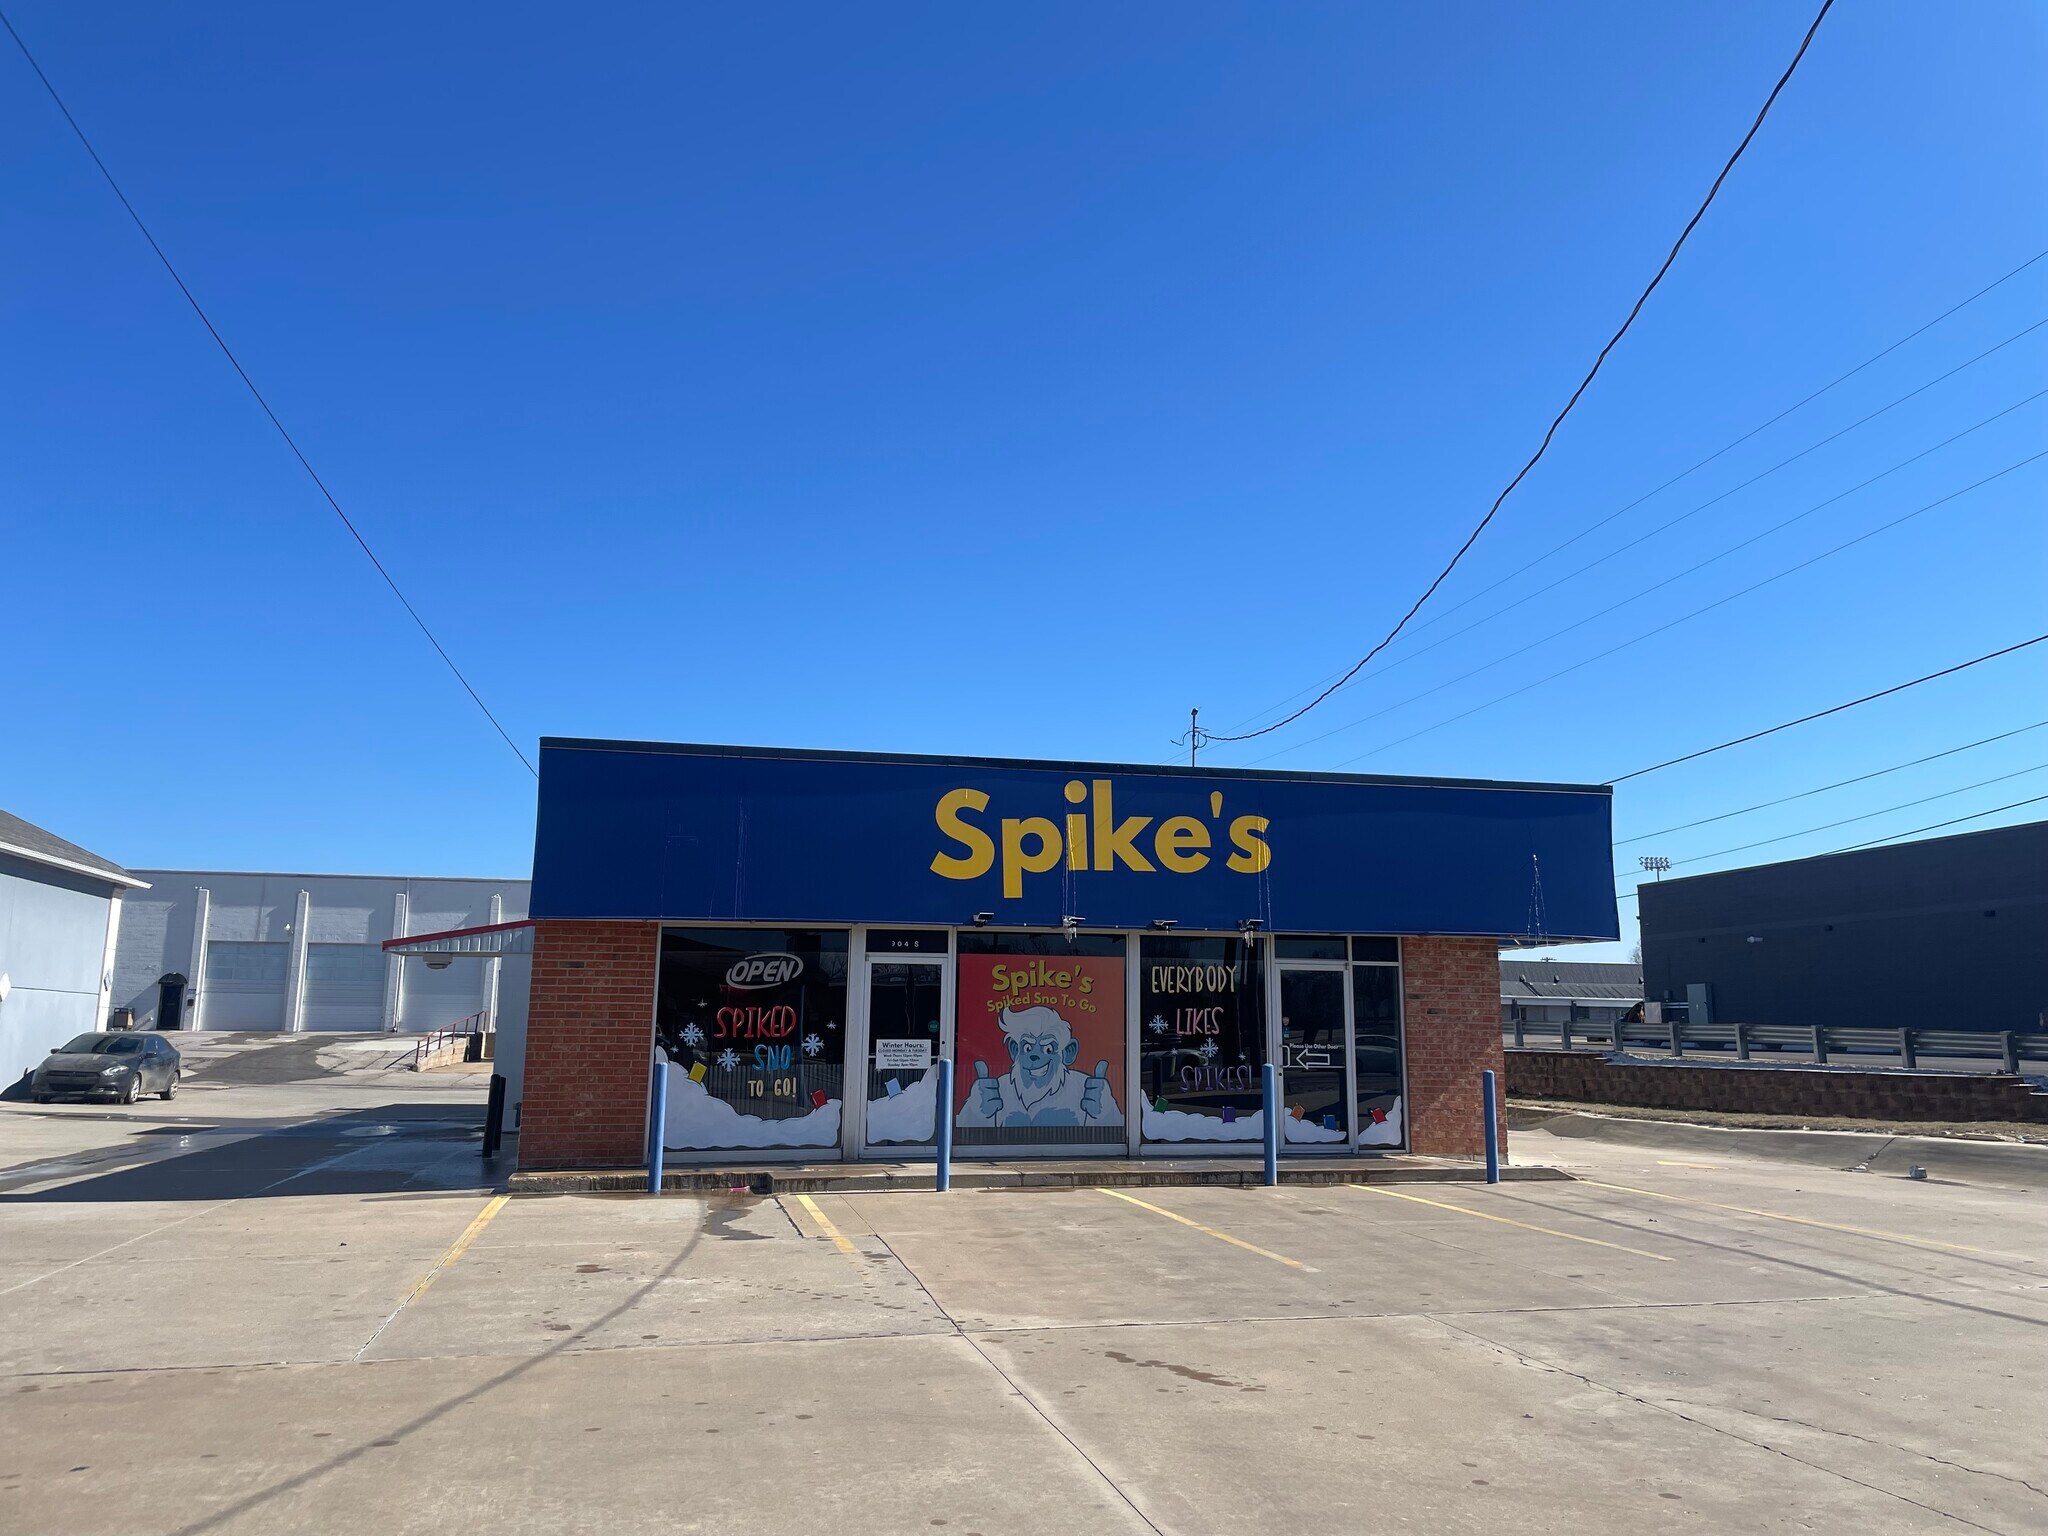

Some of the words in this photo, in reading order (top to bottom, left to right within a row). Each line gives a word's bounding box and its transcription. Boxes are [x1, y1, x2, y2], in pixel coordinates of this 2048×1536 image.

[929, 779, 1272, 898] Spike's
[731, 959, 796, 982] OPEN
[991, 959, 1095, 996] Spike's
[1151, 965, 1238, 994] EVERYBODY
[986, 992, 1031, 1013] Spiked
[1034, 992, 1058, 1005] Sno
[1061, 994, 1076, 1007] To
[1079, 999, 1097, 1013] Go
[713, 1005, 797, 1039] SPIKED
[1176, 1006, 1224, 1035] LIKES
[752, 1044, 792, 1072] SNO
[747, 1079, 764, 1097] TO
[774, 1077, 797, 1098] GO!
[1180, 1065, 1253, 1092] SPIKES!
